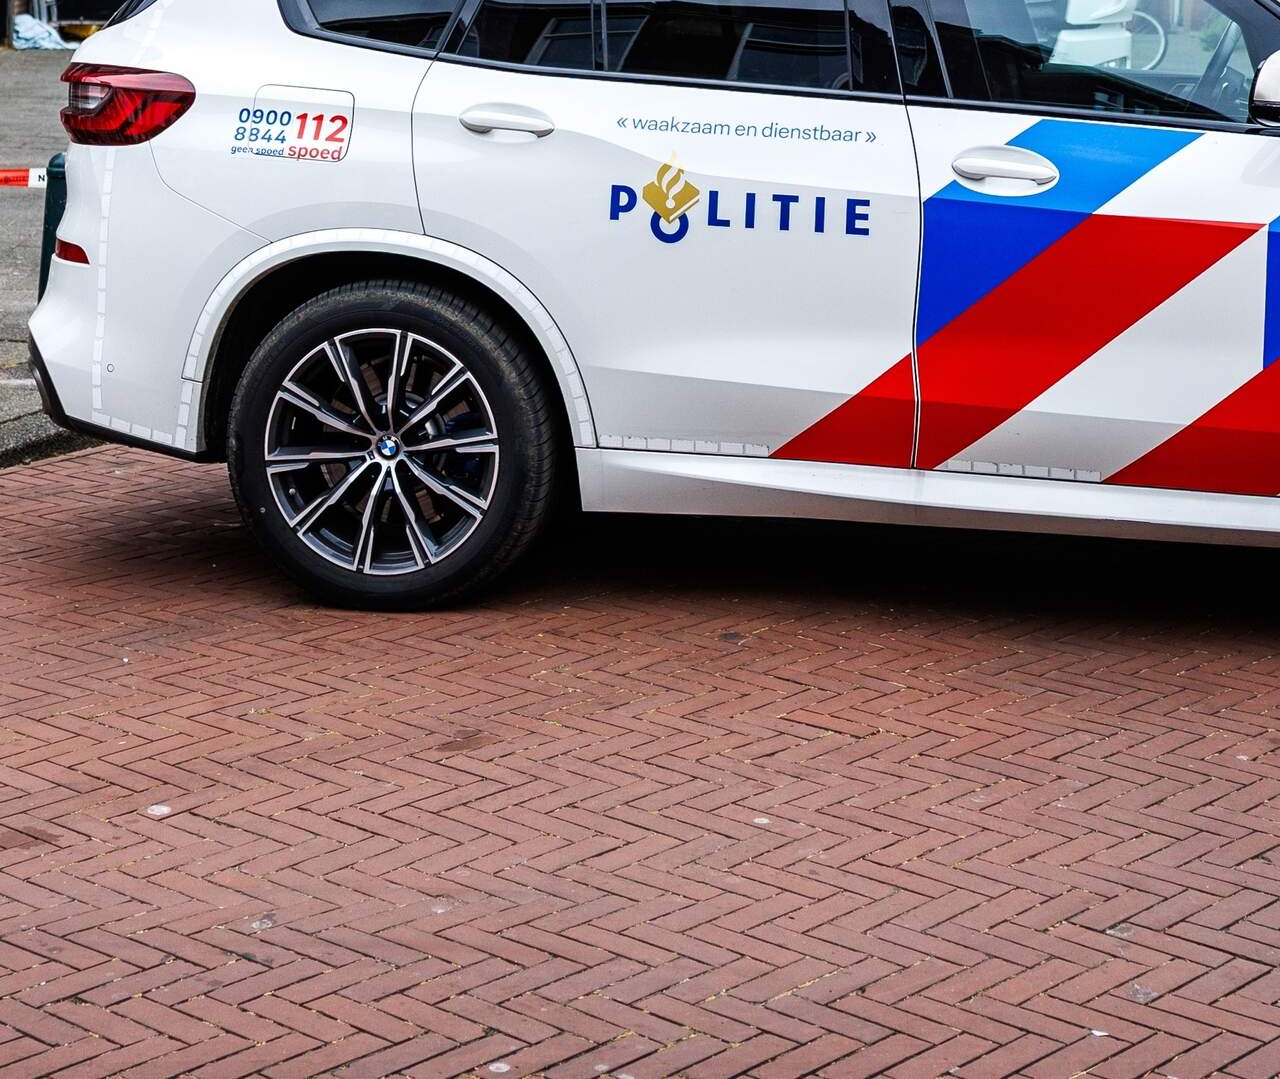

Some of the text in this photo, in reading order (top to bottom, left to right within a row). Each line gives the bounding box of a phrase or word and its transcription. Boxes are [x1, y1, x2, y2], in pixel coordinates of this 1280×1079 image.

[238, 107, 292, 127] 0900
[234, 126, 287, 144] 8844
[295, 112, 349, 143] 112
[632, 116, 731, 136] waakzaam
[734, 124, 758, 137] en
[761, 122, 862, 142] dienstbaar
[230, 145, 285, 157] geen spoed
[287, 145, 343, 161] spoed
[609, 184, 871, 244] POLITIE
